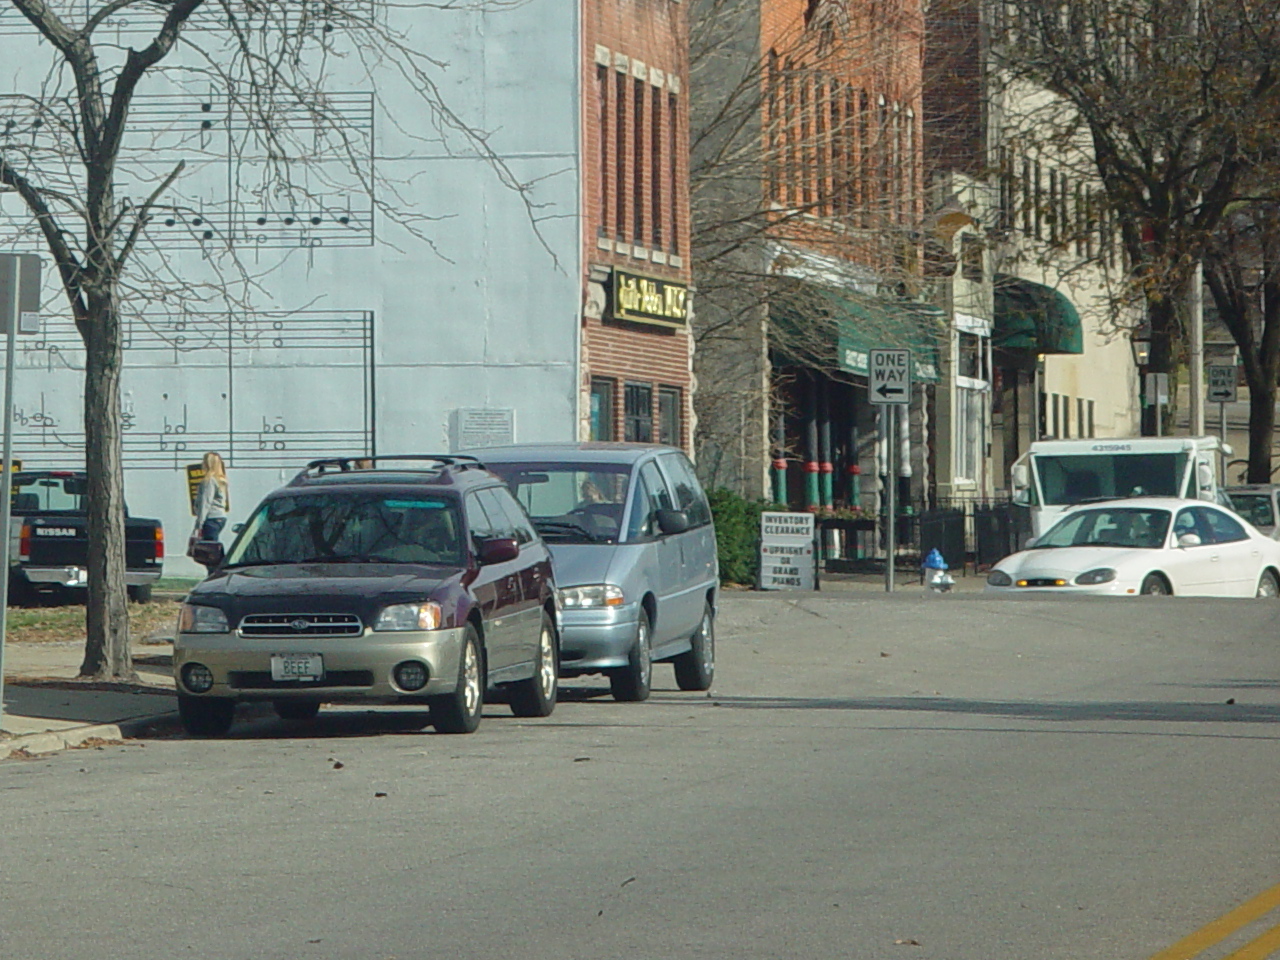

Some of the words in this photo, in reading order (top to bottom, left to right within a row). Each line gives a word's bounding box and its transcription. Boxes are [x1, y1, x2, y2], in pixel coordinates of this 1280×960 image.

[875, 353, 906, 367] ONE
[874, 369, 906, 381] WAY
[765, 515, 810, 525] INVENTORY
[36, 527, 76, 537] NISSAN
[764, 525, 811, 535] CLEARANCE
[769, 546, 803, 555] UPRIGHT
[772, 566, 799, 575] GRAND
[772, 577, 801, 586] PIANOS
[283, 660, 311, 675] BEEF
